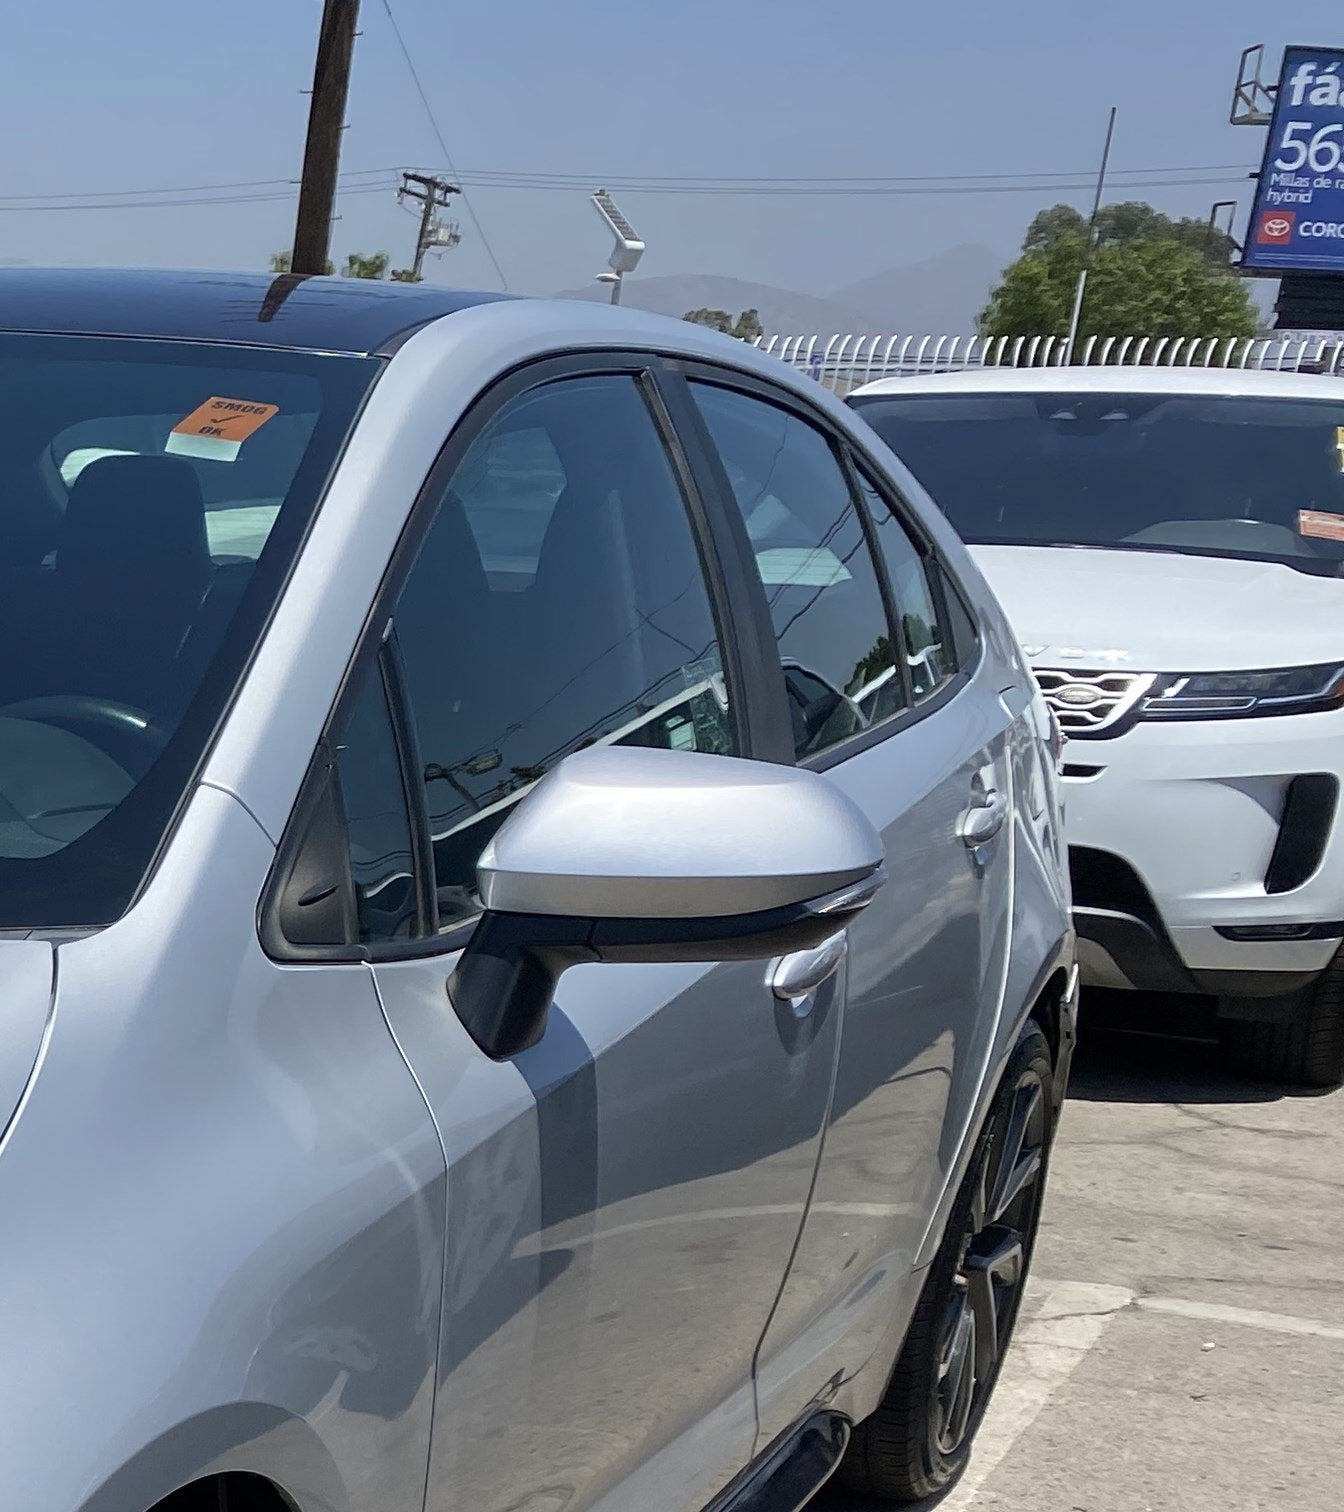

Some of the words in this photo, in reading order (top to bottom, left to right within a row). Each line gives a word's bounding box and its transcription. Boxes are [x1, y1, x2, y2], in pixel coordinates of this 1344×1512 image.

[1290, 62, 1344, 107] fá
[1274, 122, 1344, 173] 56
[1270, 173, 1310, 188] Millas
[1313, 174, 1332, 188] de
[1266, 188, 1312, 205] hybrid
[211, 401, 268, 415] SMOG
[199, 426, 226, 436] OK
